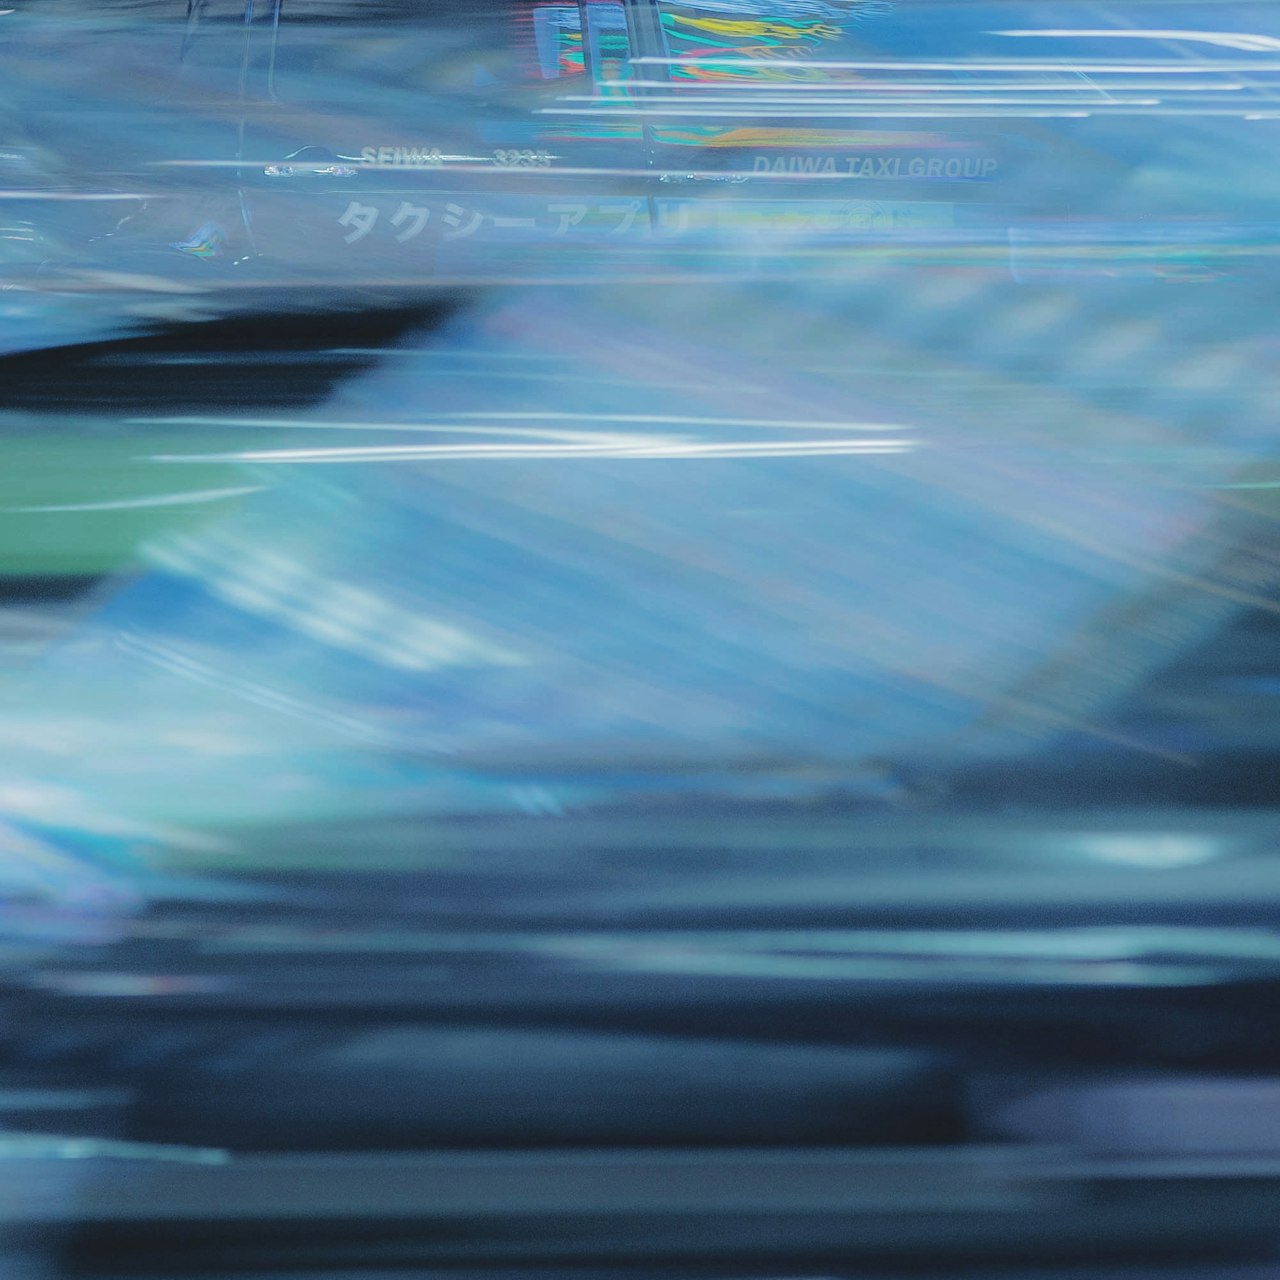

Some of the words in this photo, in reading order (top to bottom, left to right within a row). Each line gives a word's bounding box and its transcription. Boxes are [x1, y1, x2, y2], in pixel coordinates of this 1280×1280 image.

[360, 147, 443, 167] SEIWA
[493, 149, 552, 168] 3235
[753, 156, 837, 177] DAIWA
[845, 157, 901, 177] TAXI
[907, 158, 998, 178] GROUP
[338, 201, 689, 244] タクシーアプリ
